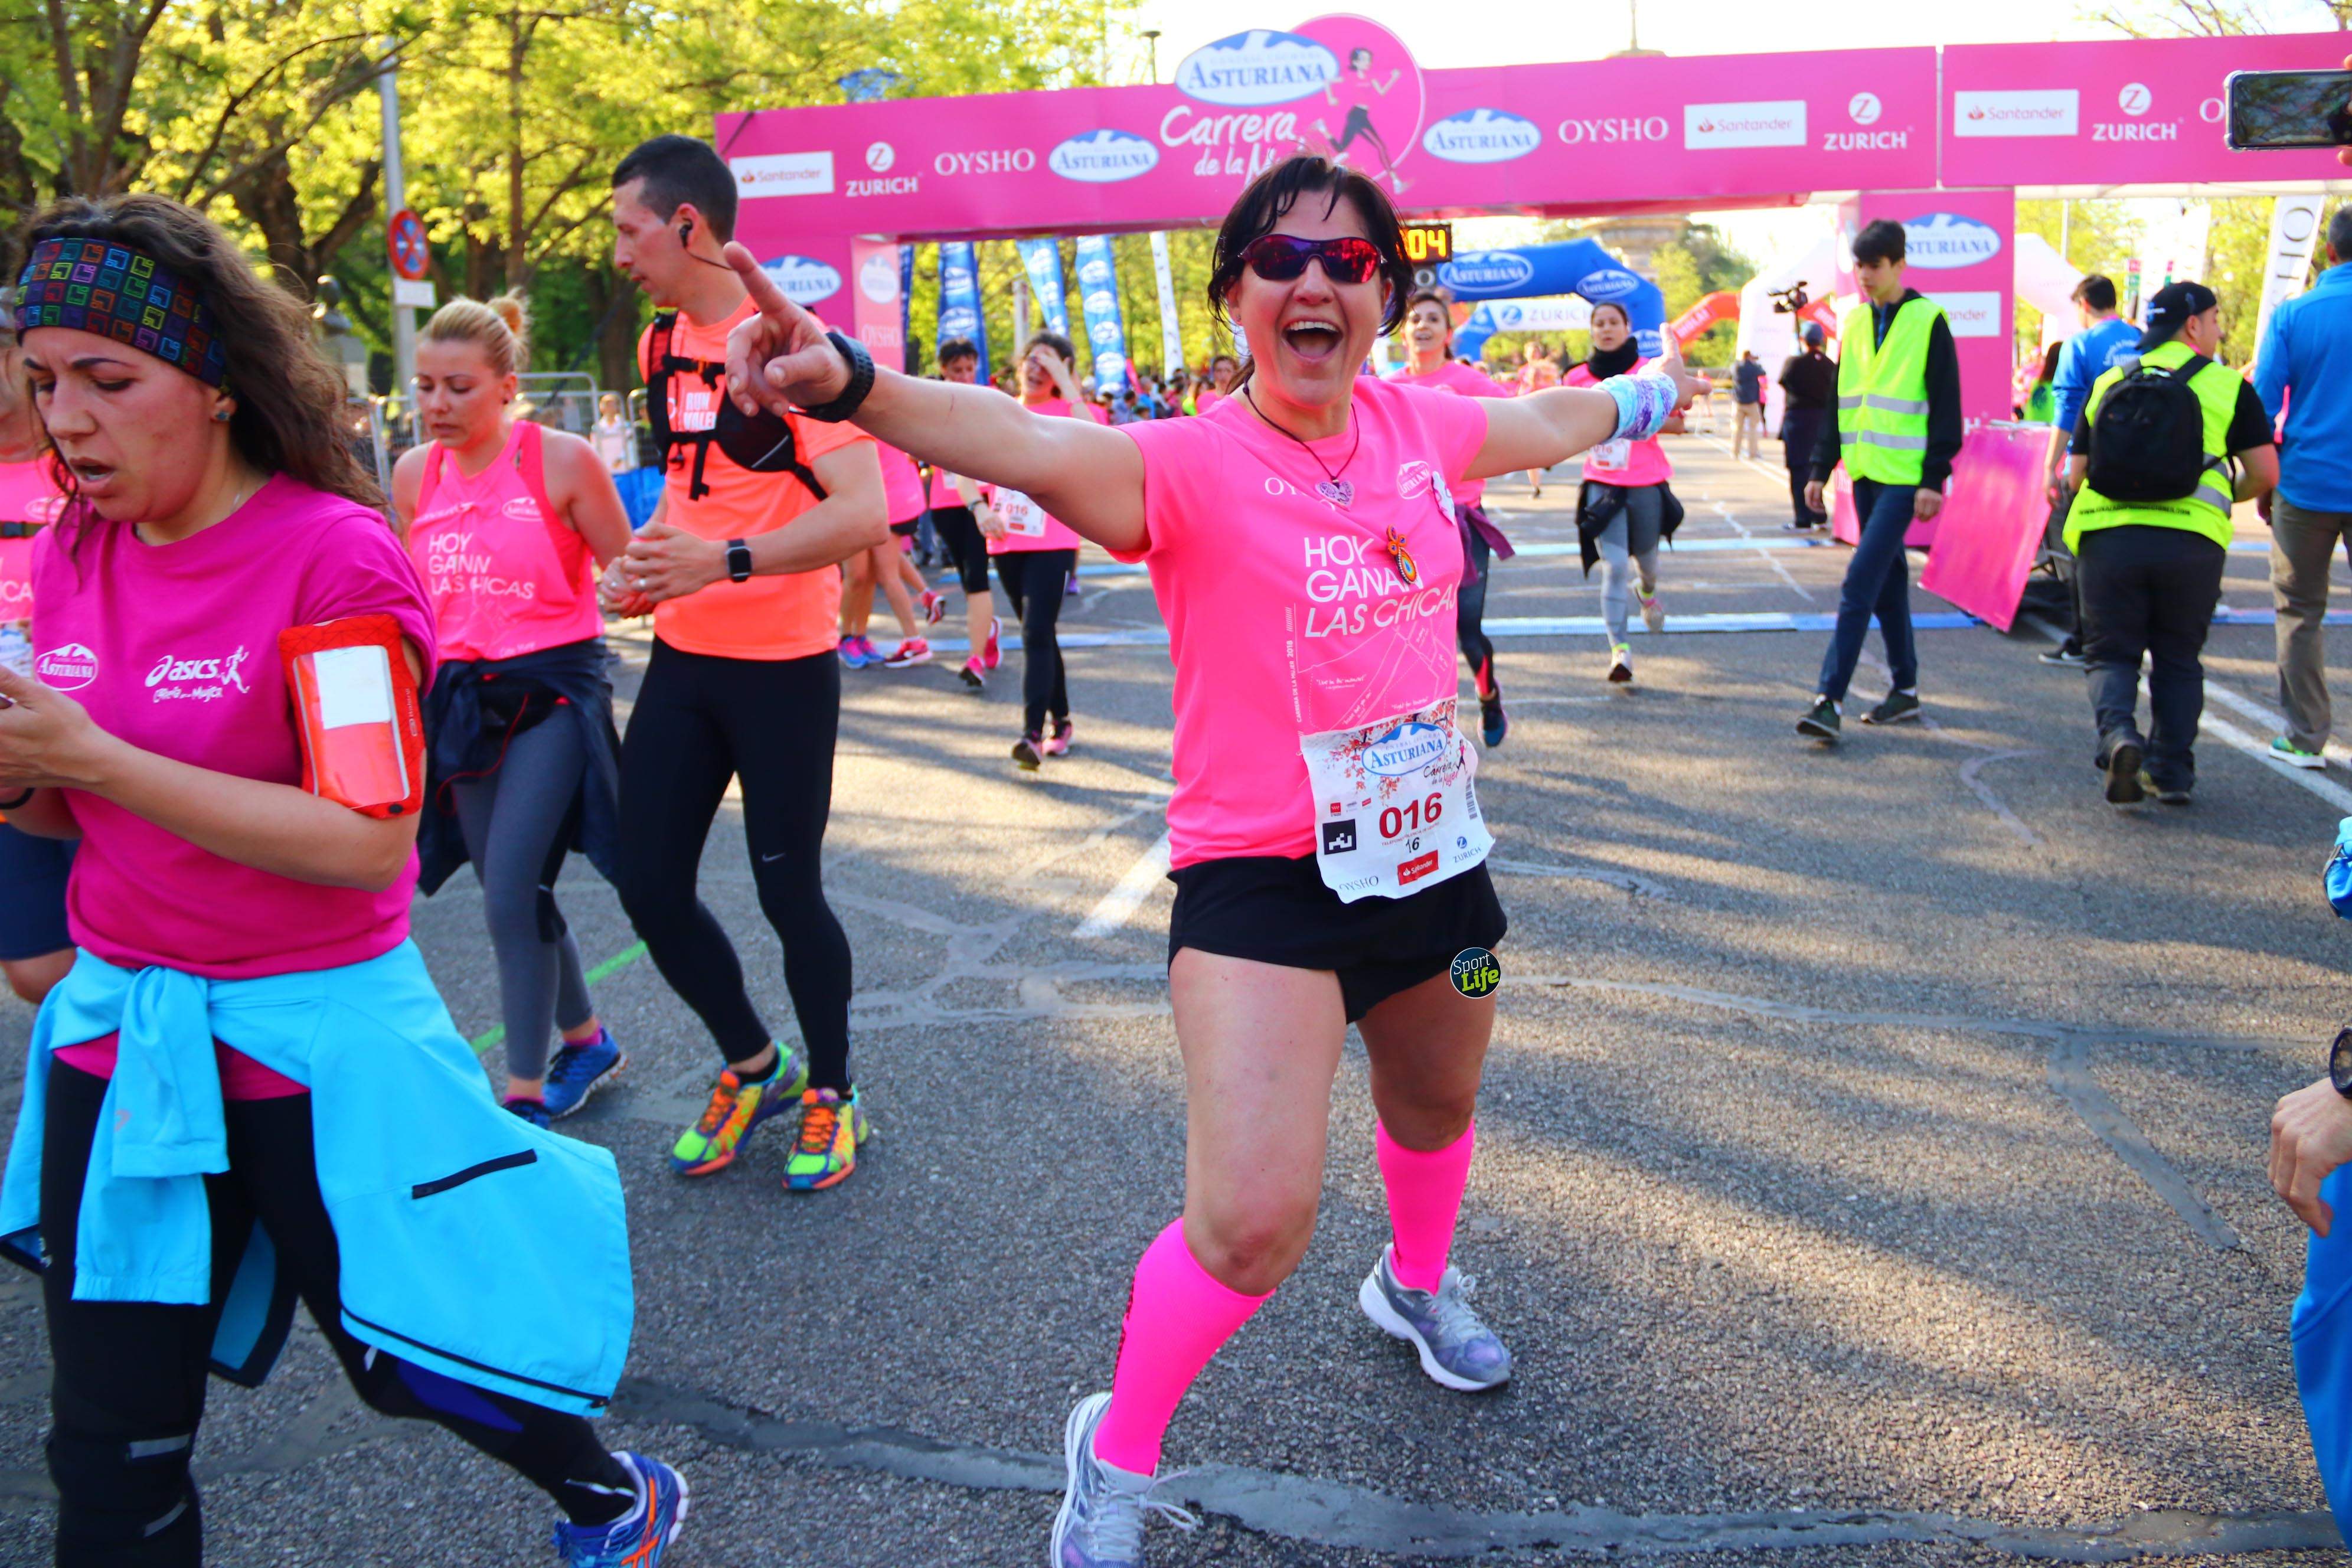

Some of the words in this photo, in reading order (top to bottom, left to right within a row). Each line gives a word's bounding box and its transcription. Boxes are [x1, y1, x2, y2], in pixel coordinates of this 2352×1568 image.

[1188, 61, 1326, 89] ASTURIANA
[1987, 105, 2064, 120] Santander
[1160, 105, 1298, 147] Carrera
[1559, 116, 1669, 145] OYSHO
[1717, 117, 1792, 133] Santander
[2092, 123, 2177, 142] ZURICH
[1433, 131, 1531, 149] ASTURIANA
[1823, 131, 1907, 151] ZURICH
[935, 148, 1035, 175] OYSHO
[1058, 149, 1149, 169] ASTURIANA
[1194, 147, 1221, 176] de
[1225, 146, 1244, 175] la
[757, 168, 821, 183] Santander
[845, 177, 919, 197] ZURICH
[1905, 239, 1991, 254] STURIANA
[777, 279, 834, 293] URIANA
[1945, 309, 1987, 321] ander
[428, 532, 472, 554] HOY
[430, 574, 465, 596] LAS
[1304, 603, 1368, 638] LAS
[1286, 640, 1294, 658] 2018
[1370, 738, 1444, 769] ASTURIANA
[1379, 792, 1442, 839] 016
[1406, 837, 1420, 853] 16
[1453, 847, 1482, 863] ZURICH
